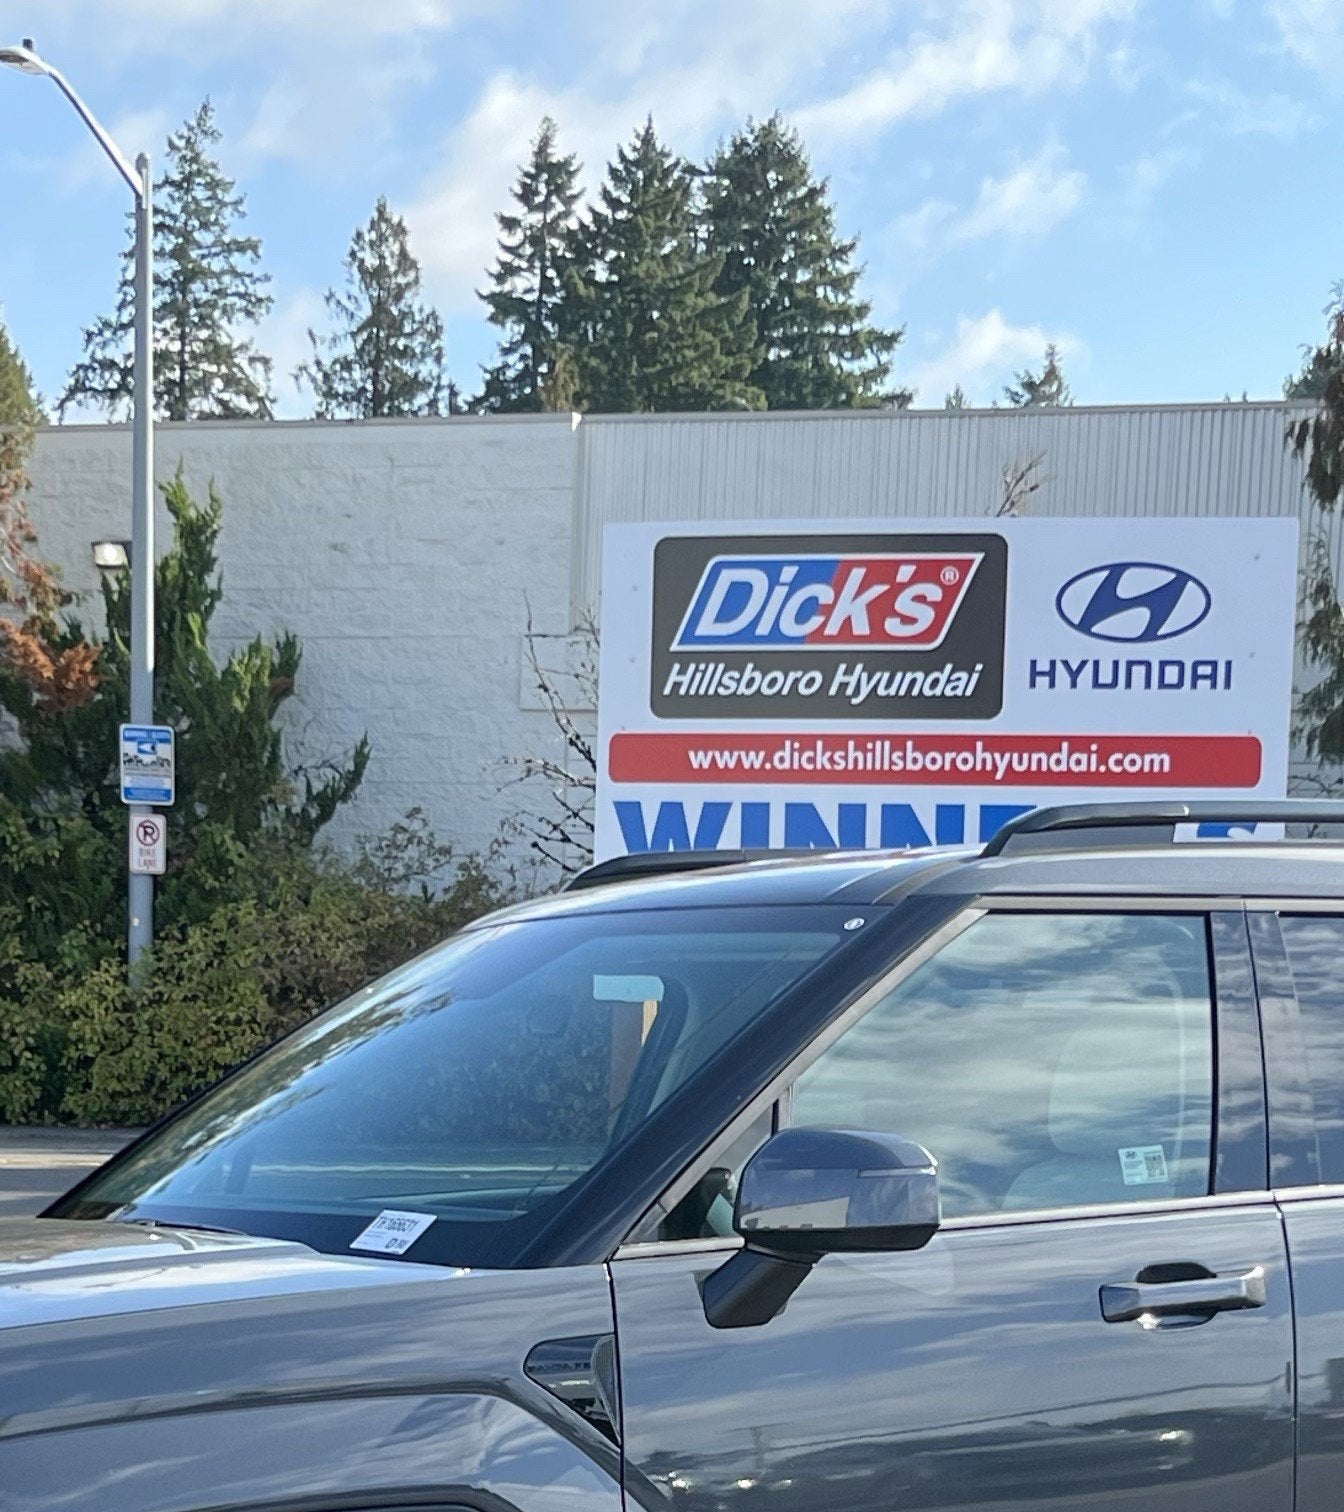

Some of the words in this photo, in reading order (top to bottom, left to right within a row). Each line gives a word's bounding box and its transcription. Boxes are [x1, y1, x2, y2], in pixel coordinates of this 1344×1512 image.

[695, 564, 944, 638] Dick's
[663, 662, 823, 696] Hillsboro
[828, 663, 984, 705] Hyundai
[1029, 659, 1233, 690] HYUNDAI
[688, 740, 1171, 781] www.dickshillsborohyundai.com
